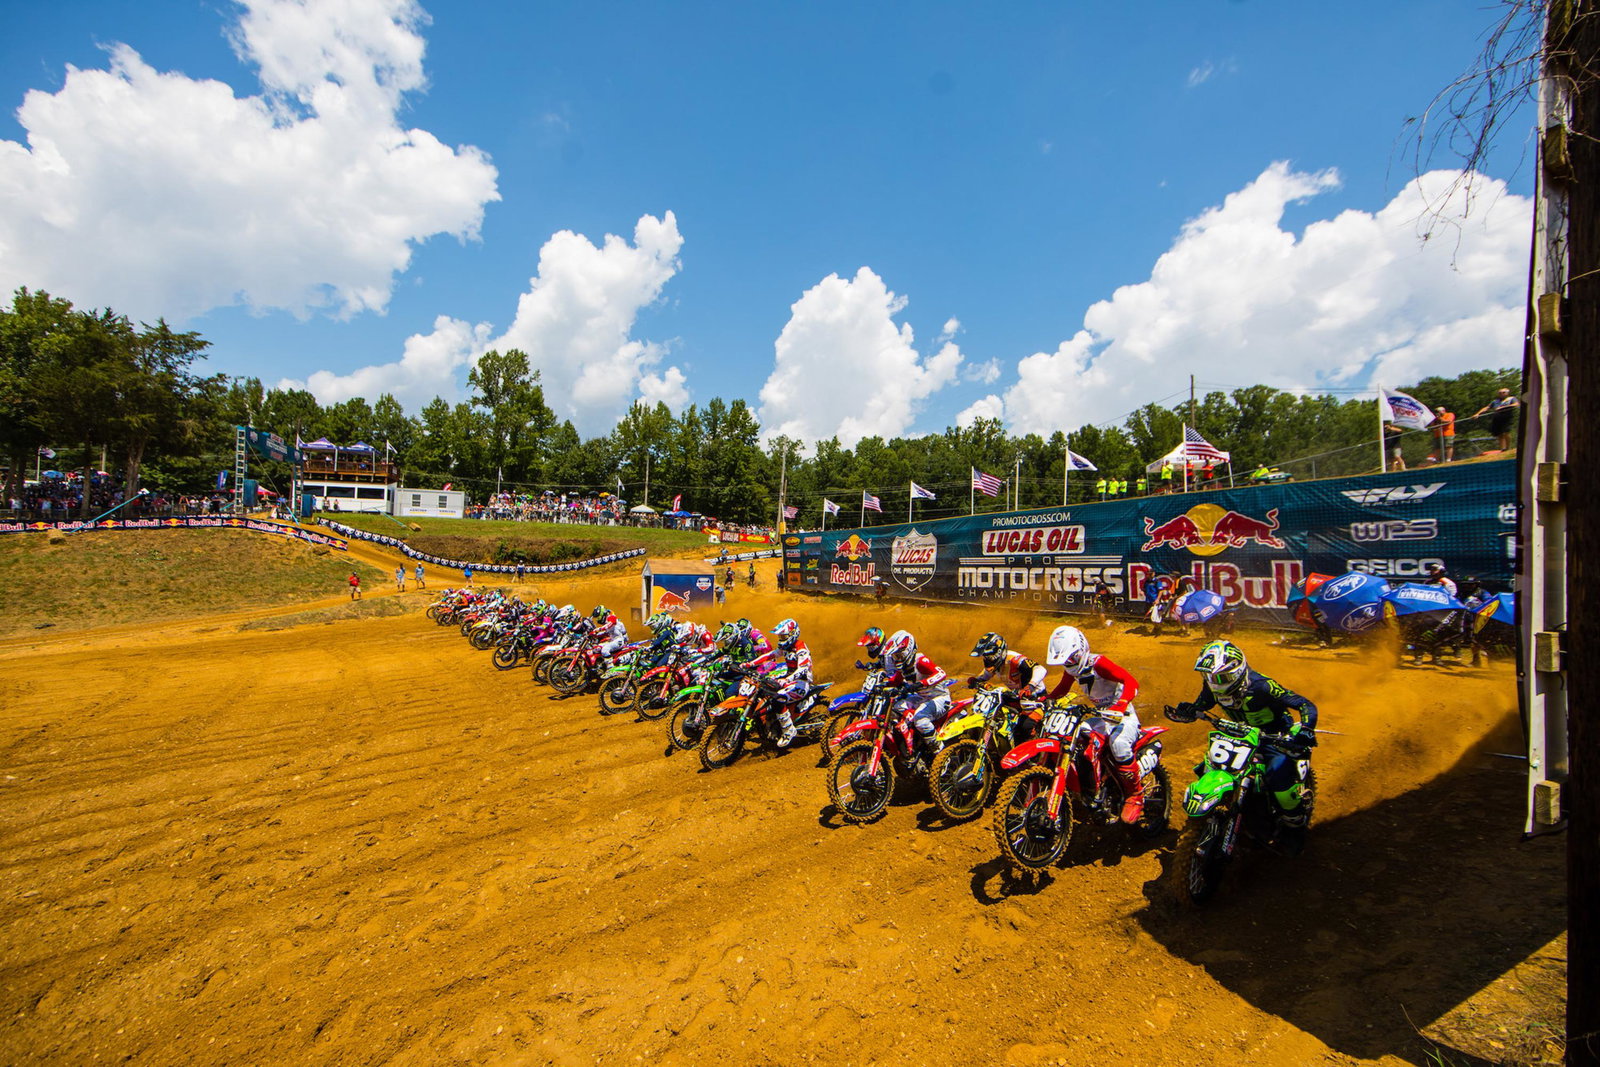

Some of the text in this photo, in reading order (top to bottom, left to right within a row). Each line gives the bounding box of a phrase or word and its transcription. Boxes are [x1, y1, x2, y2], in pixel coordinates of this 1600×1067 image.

[1341, 482, 1447, 503] FLY
[992, 512, 1071, 526] PROMOTOCROSS.COM
[1350, 518, 1439, 542] WPS
[986, 527, 1081, 553] LUCAS OIL
[896, 548, 935, 564] LUCAS
[1008, 556, 1052, 565] PRO
[1346, 558, 1446, 576] GEICO
[830, 562, 853, 585] Red
[852, 562, 875, 587] Bull
[958, 566, 1124, 594] MOTOCROSS
[1209, 559, 1304, 609] Bull
[958, 588, 1125, 606] CHAMPIONSHP
[1211, 739, 1252, 770] 61
